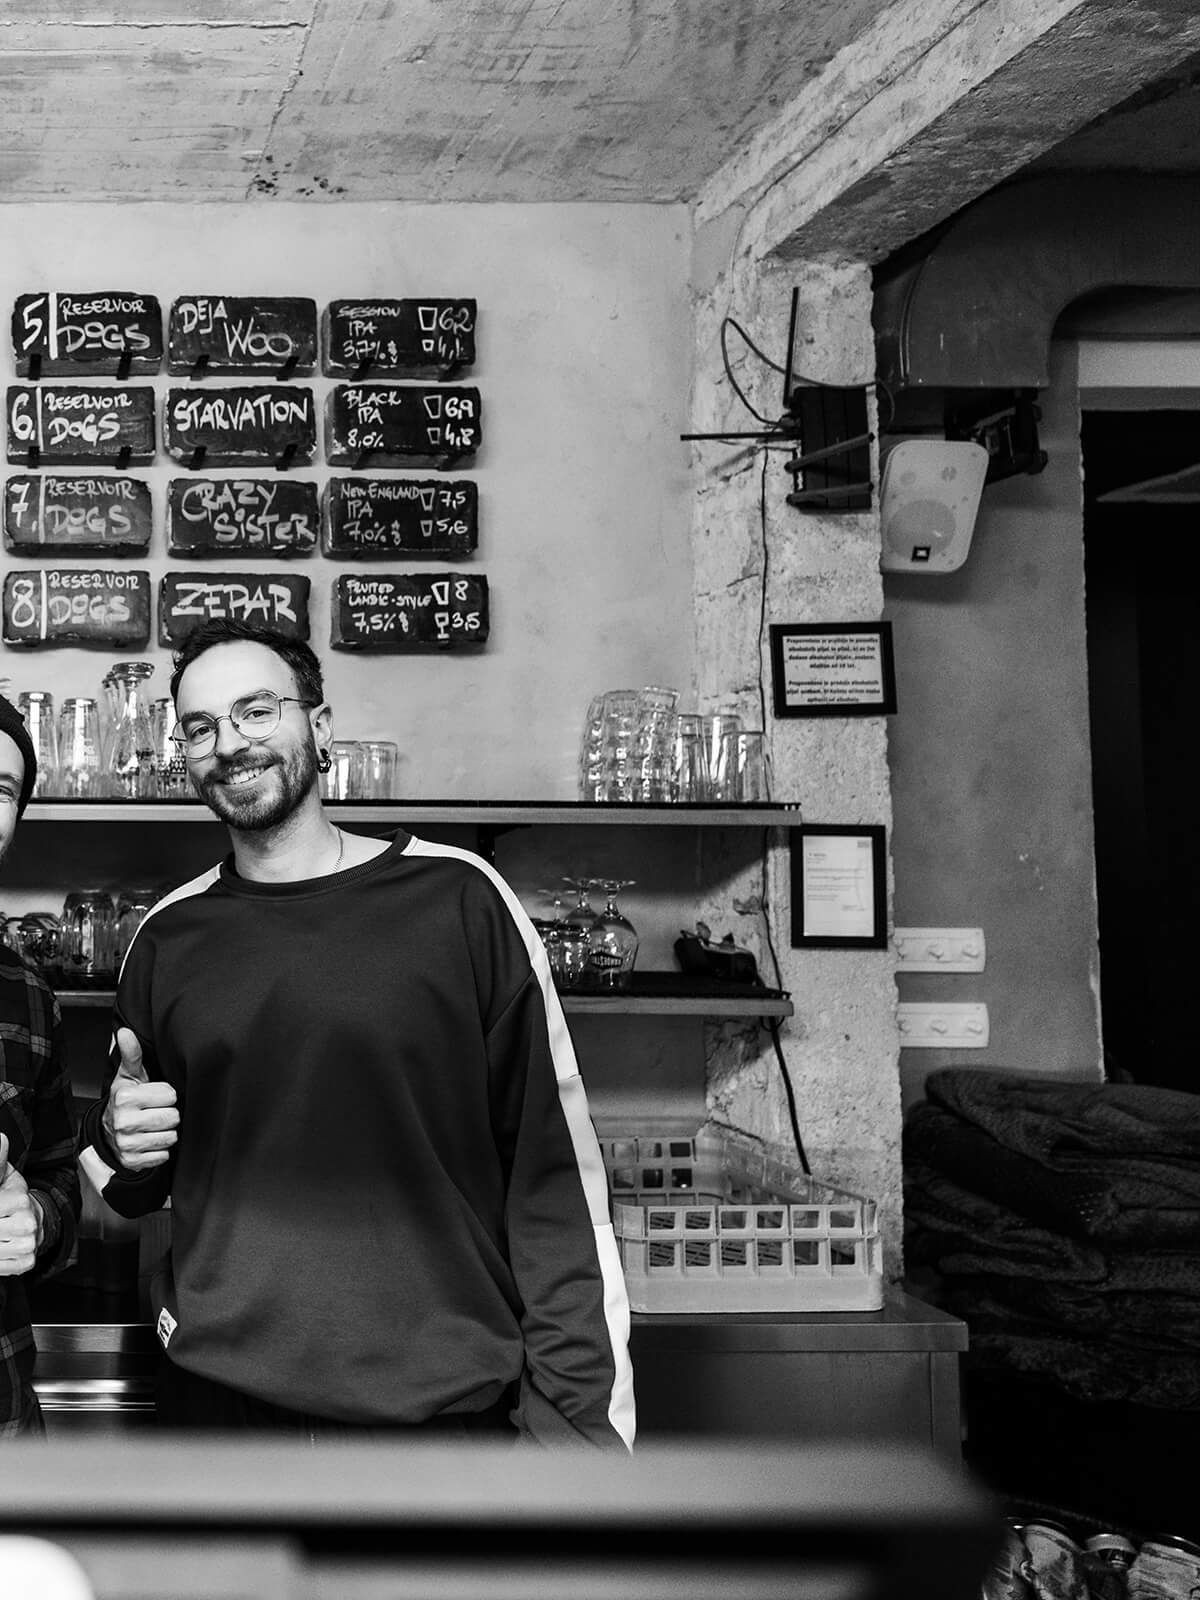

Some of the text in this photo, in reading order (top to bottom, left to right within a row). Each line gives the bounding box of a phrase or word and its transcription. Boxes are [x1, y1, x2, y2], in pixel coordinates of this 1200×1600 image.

[59, 298, 147, 320] RESERVOIR
[179, 300, 228, 334] DEJA
[337, 306, 400, 319] SESSION
[57, 322, 150, 352] DOGS
[349, 320, 378, 336] IPA
[45, 393, 132, 411] RESERVOIR
[343, 389, 401, 409] BLACK
[173, 394, 308, 431] STARVATION
[358, 407, 383, 424] IPA
[49, 412, 120, 446] DOGS
[46, 479, 136, 500] RESERVOIR
[181, 481, 277, 523] CRAZY
[348, 500, 373, 518] IPA
[46, 504, 131, 538] DOGS
[49, 572, 140, 591] RESERVOIR
[455, 580, 468, 600] 8
[49, 594, 130, 625] DOGS
[171, 583, 297, 622] ZEPAR
